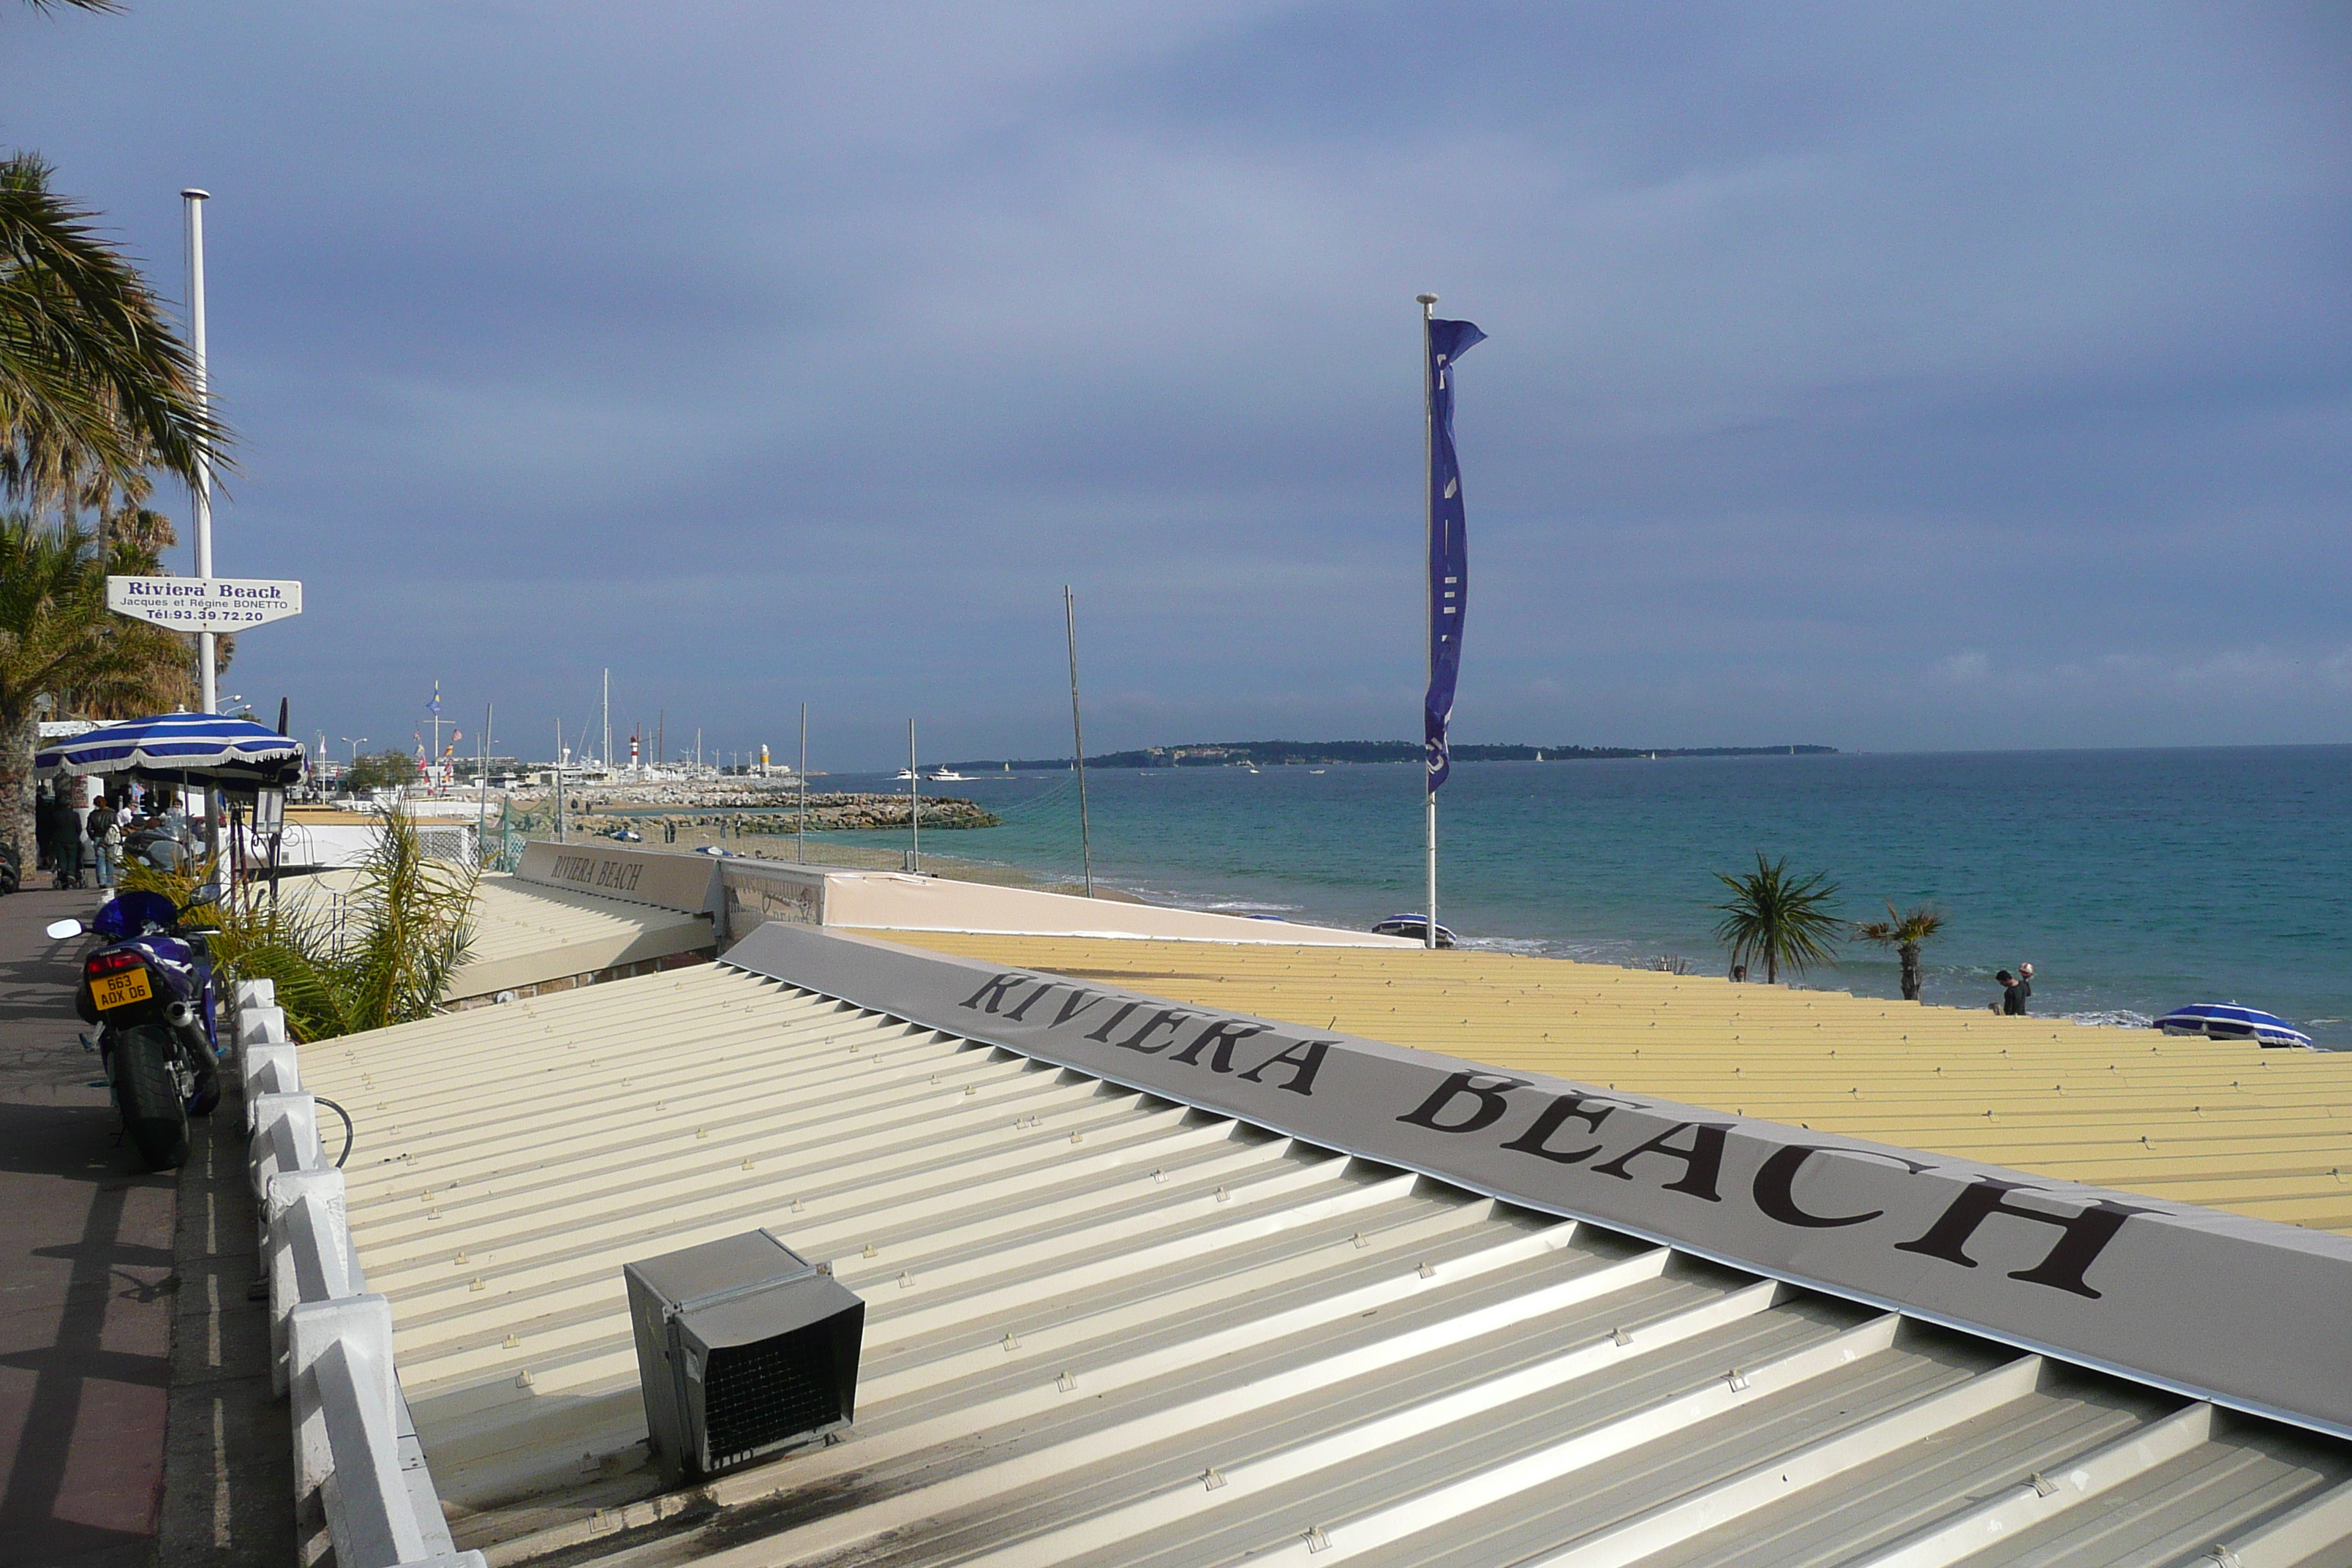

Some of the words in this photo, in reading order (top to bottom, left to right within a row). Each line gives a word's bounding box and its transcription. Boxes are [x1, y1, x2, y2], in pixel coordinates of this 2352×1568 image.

[128, 582, 206, 596] Riviera
[219, 584, 281, 598] Beach
[120, 598, 168, 607] Jacques
[190, 599, 228, 608] Régine
[234, 600, 287, 608] BONETTO
[551, 856, 596, 883] RIVIERA
[596, 861, 644, 891] BEACH
[107, 975, 132, 991] 663
[129, 985, 146, 999] 06
[958, 972, 1344, 1096] RIVIERA
[1395, 1068, 2178, 1300] BEACH
